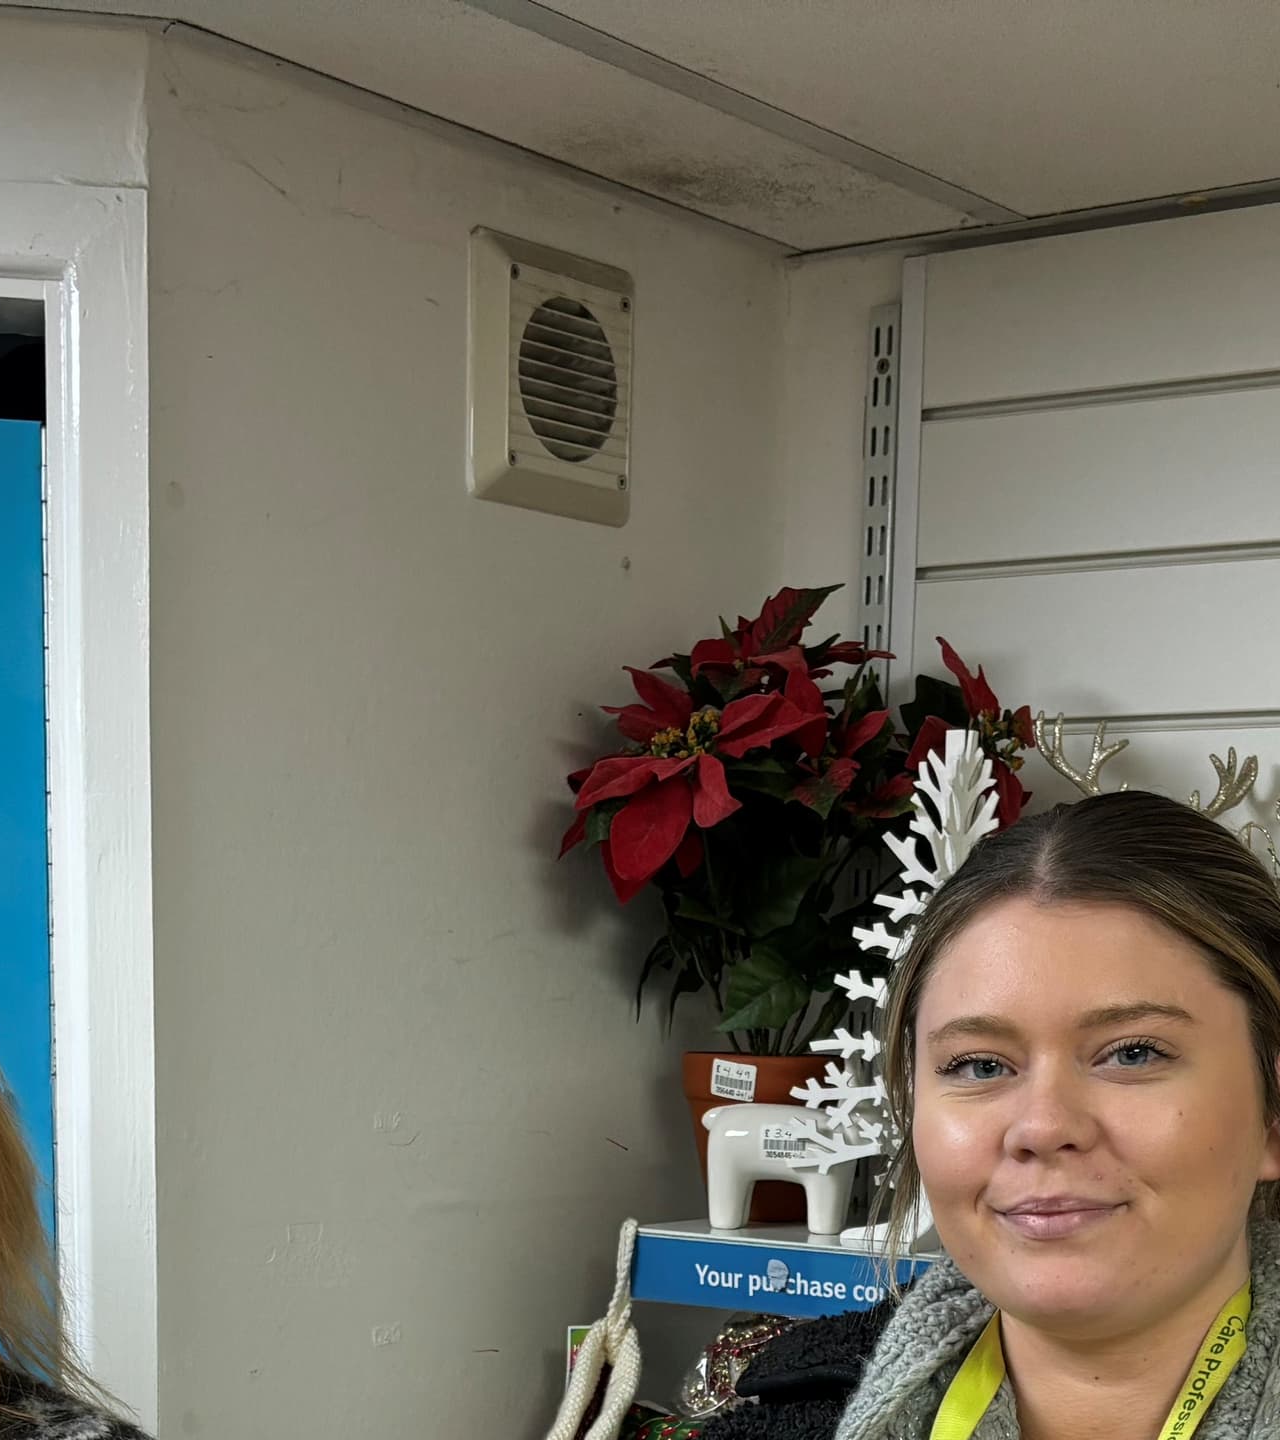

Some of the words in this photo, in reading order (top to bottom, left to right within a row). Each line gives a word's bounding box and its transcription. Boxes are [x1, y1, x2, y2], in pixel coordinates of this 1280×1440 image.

[695, 1263, 742, 1288] Your
[748, 1268, 846, 1299] puchase
[1210, 1315, 1244, 1354] Care
